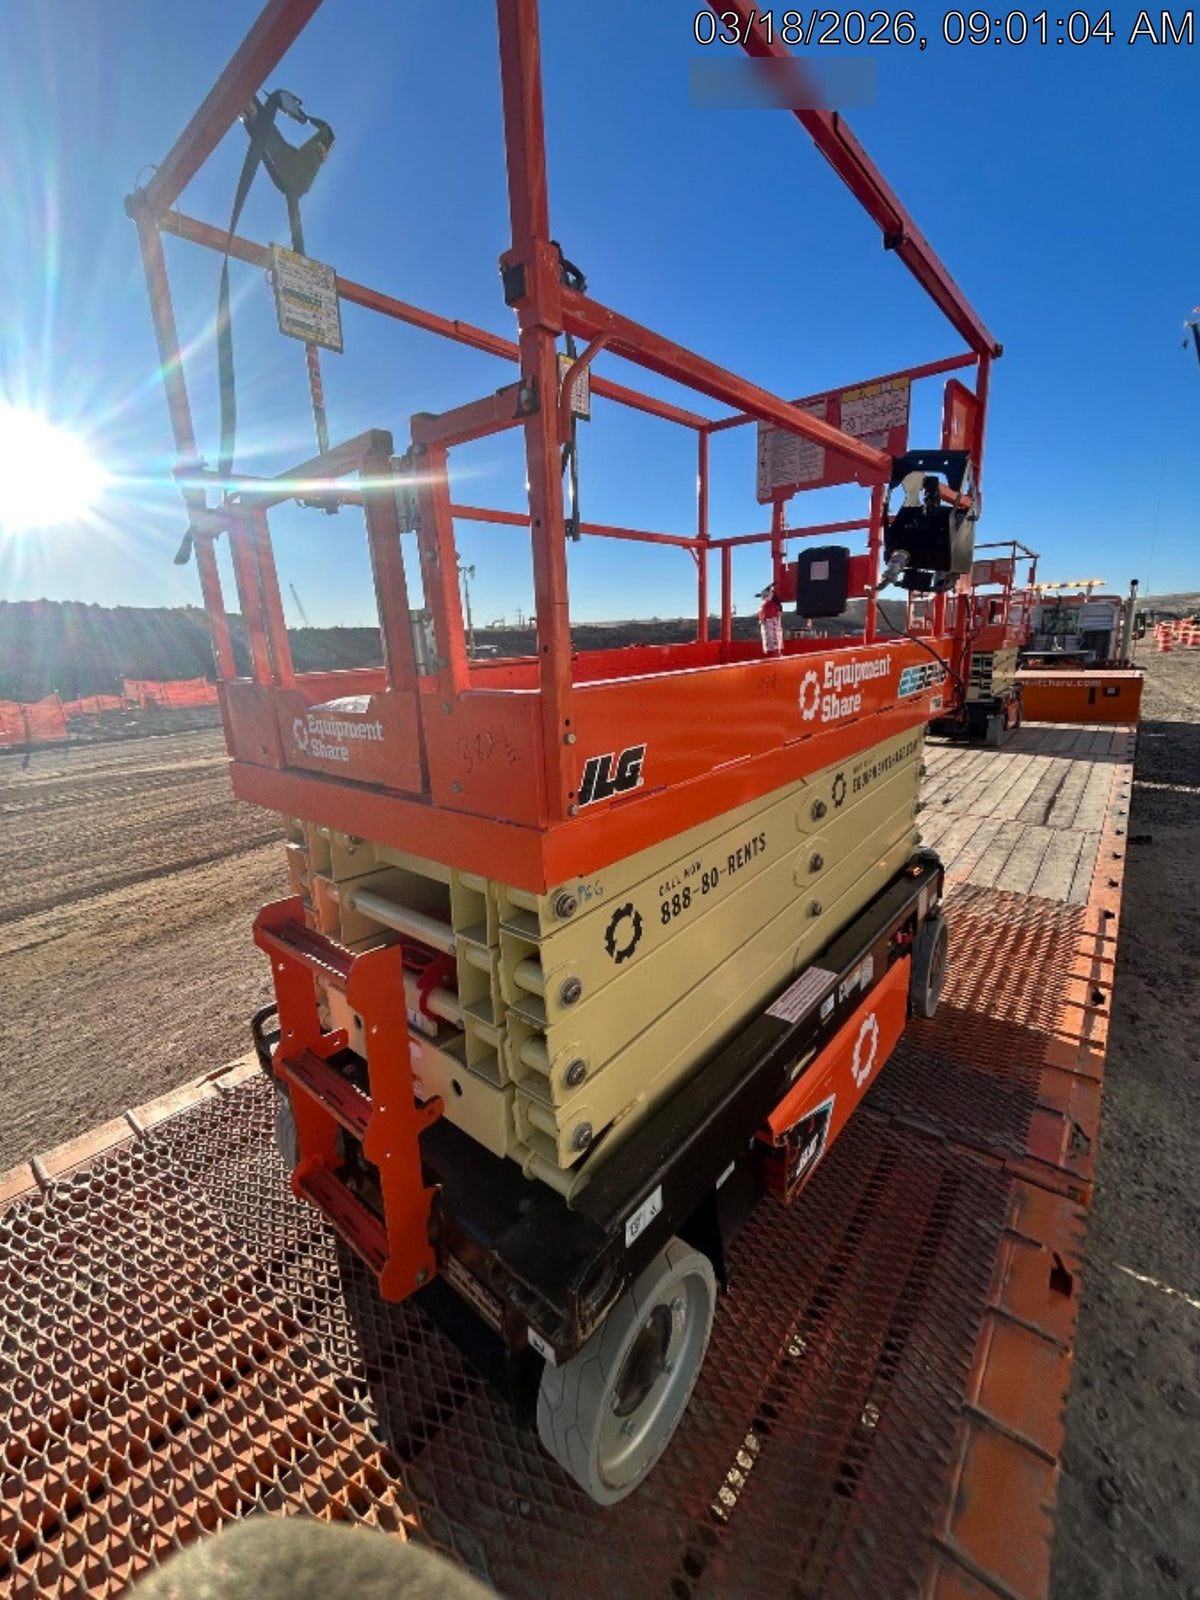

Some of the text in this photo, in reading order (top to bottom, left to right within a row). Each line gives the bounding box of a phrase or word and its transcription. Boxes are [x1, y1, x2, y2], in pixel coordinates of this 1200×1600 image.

[822, 653, 892, 693] Equipment
[821, 693, 863, 723] Share
[306, 713, 384, 742] Equipment
[310, 738, 350, 762] Share
[578, 743, 647, 808] JLG
[659, 860, 702, 896] CALL NOW
[660, 832, 766, 925] 888-80-RENTS
